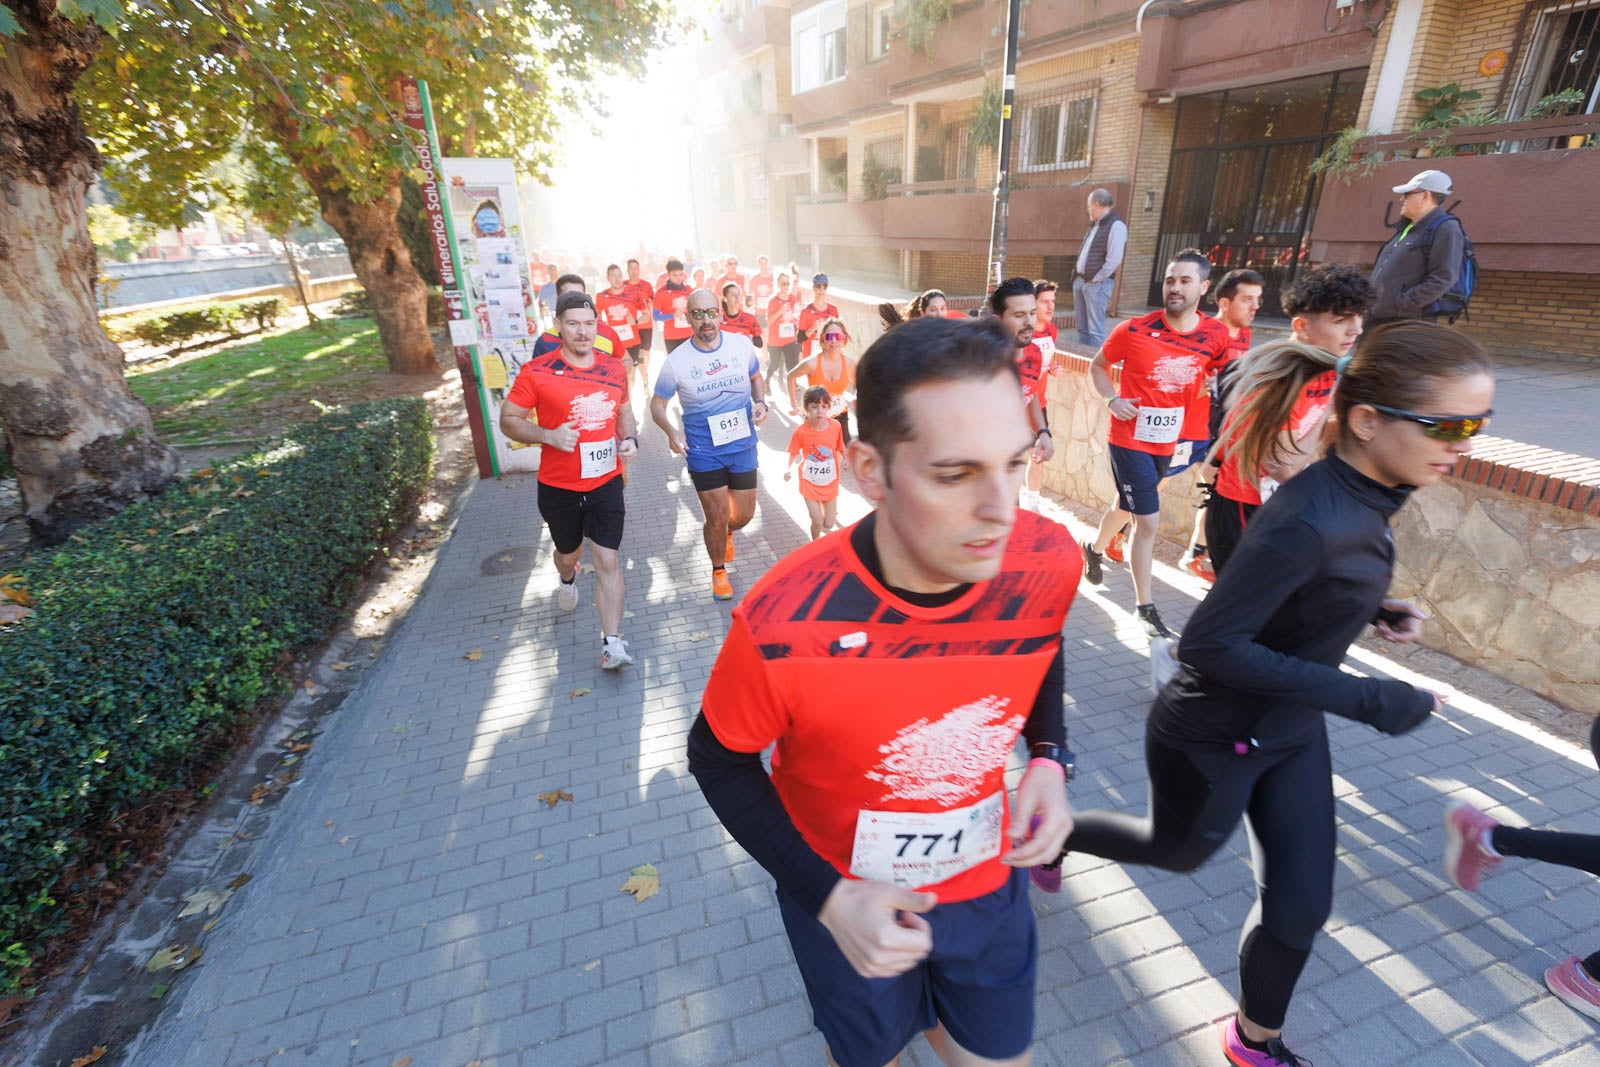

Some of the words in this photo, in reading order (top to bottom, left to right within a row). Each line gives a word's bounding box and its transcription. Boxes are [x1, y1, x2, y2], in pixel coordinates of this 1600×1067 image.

[1264, 122, 1274, 137] 2
[432, 213, 456, 284] tinerarios
[697, 375, 744, 394] MARACENA
[720, 417, 739, 430] 613
[1145, 415, 1177, 427] 1035
[589, 446, 613, 461] 1091
[895, 829, 963, 857] 771
